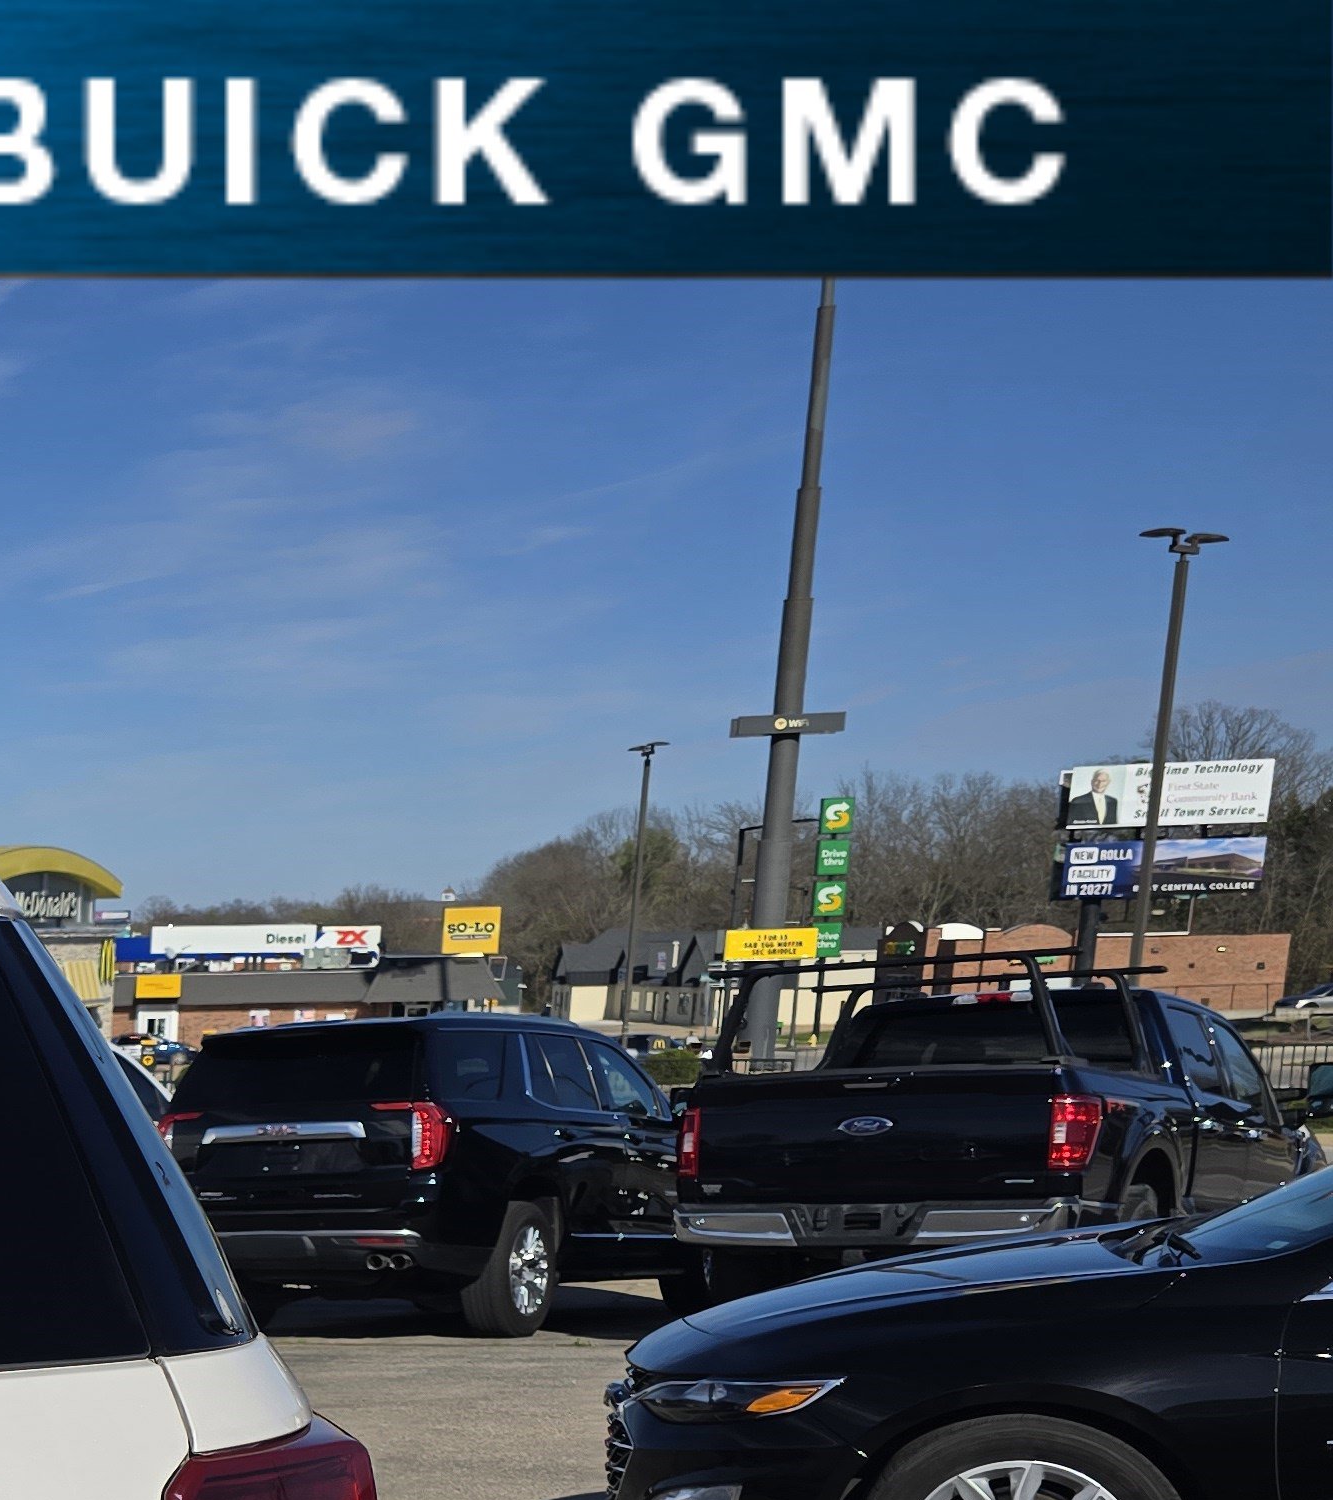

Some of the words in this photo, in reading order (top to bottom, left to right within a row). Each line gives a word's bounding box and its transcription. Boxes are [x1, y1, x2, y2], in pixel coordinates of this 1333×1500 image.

[1194, 762, 1263, 775] Technology
[1173, 808, 1204, 817] Town
[1209, 805, 1256, 817] Service
[821, 848, 848, 859] Drive
[1074, 851, 1094, 861] NEW
[1100, 849, 1133, 861] ROLLA
[823, 857, 845, 867] thru
[1072, 869, 1111, 879] FACILITY
[1066, 884, 1078, 896] IN
[1161, 882, 1206, 892] CENTRAL
[1210, 881, 1255, 891] COLLEGE
[447, 922, 495, 934] SO-LO
[265, 933, 307, 945] Diesel
